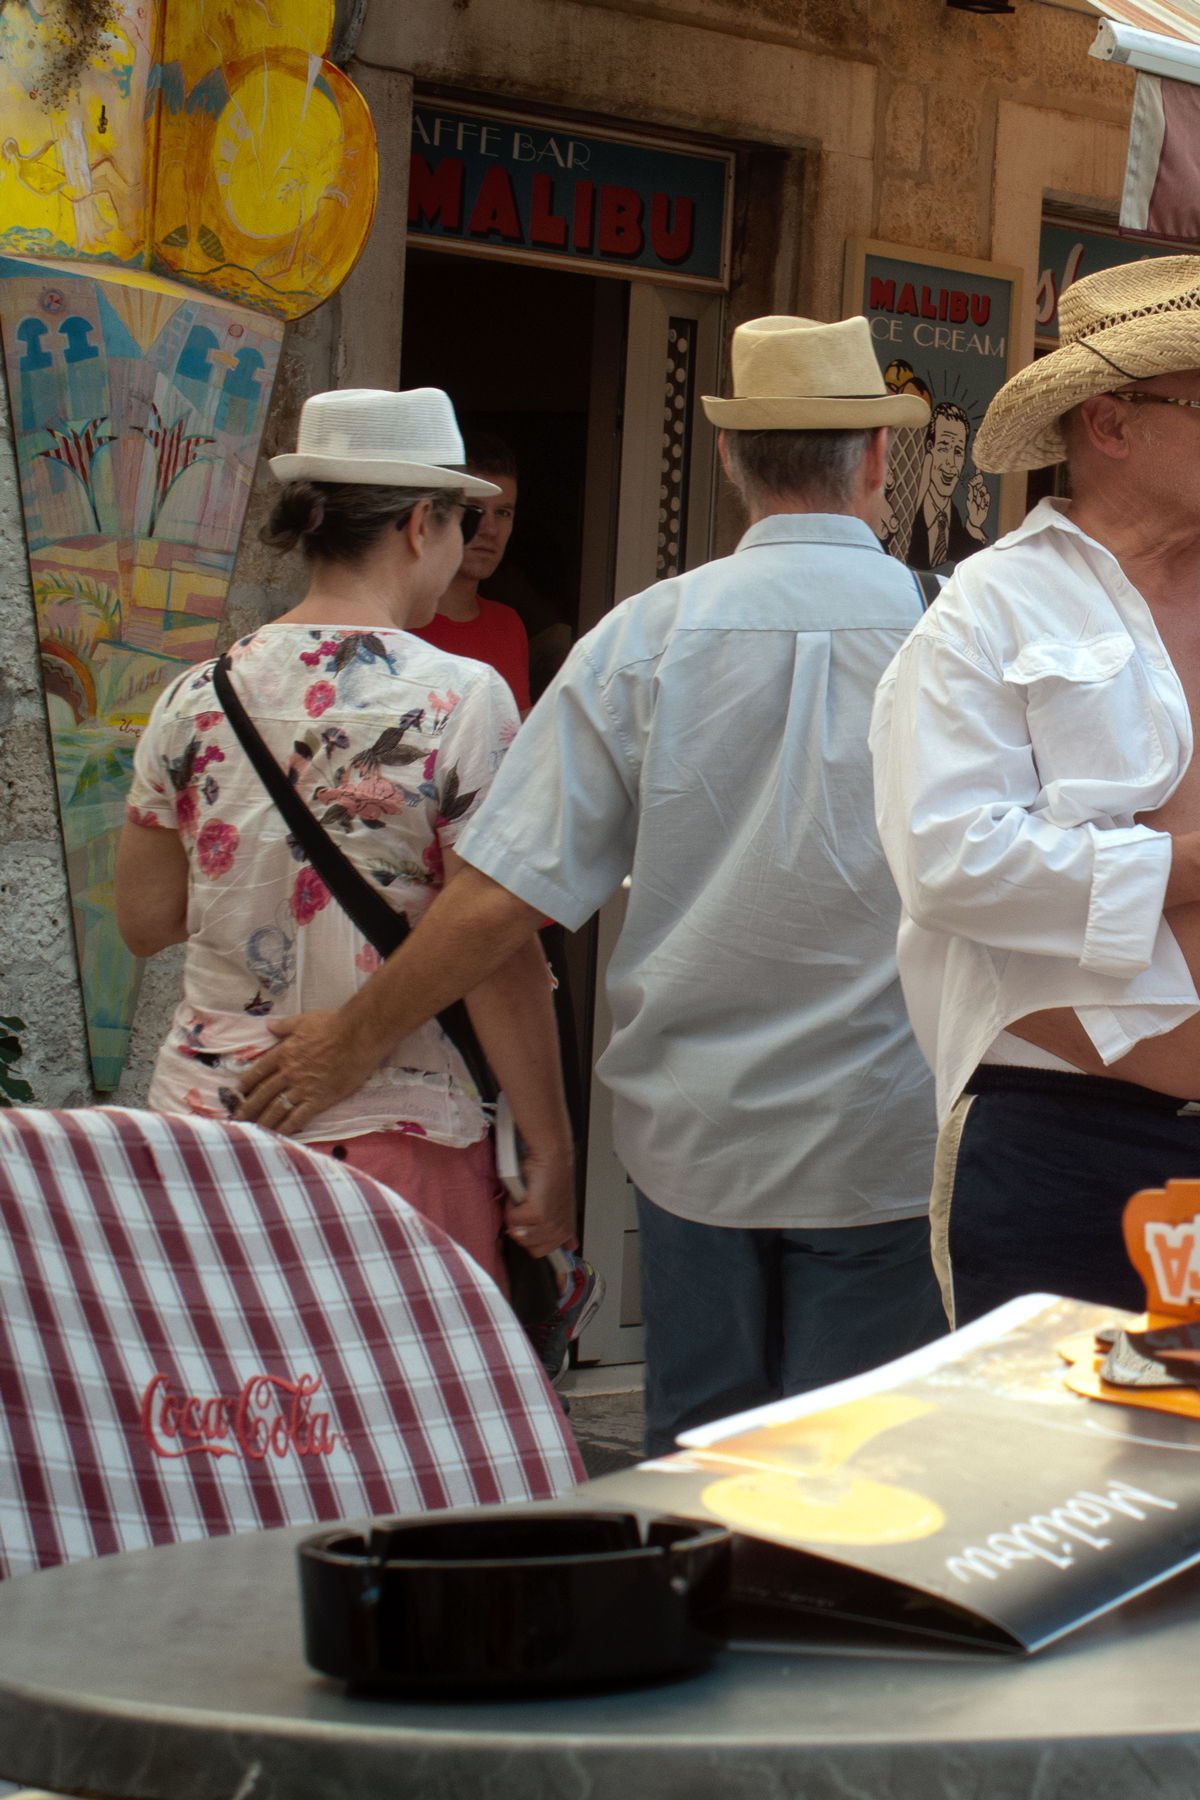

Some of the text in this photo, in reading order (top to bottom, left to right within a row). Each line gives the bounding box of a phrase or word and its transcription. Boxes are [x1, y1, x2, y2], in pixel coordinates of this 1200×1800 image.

[411, 114, 592, 172] AFFE BAR
[407, 152, 695, 262] MALIBU
[869, 276, 991, 327] MALIBU
[867, 316, 1005, 358] CE CREAM
[946, 1479, 1178, 1584] Malibu
